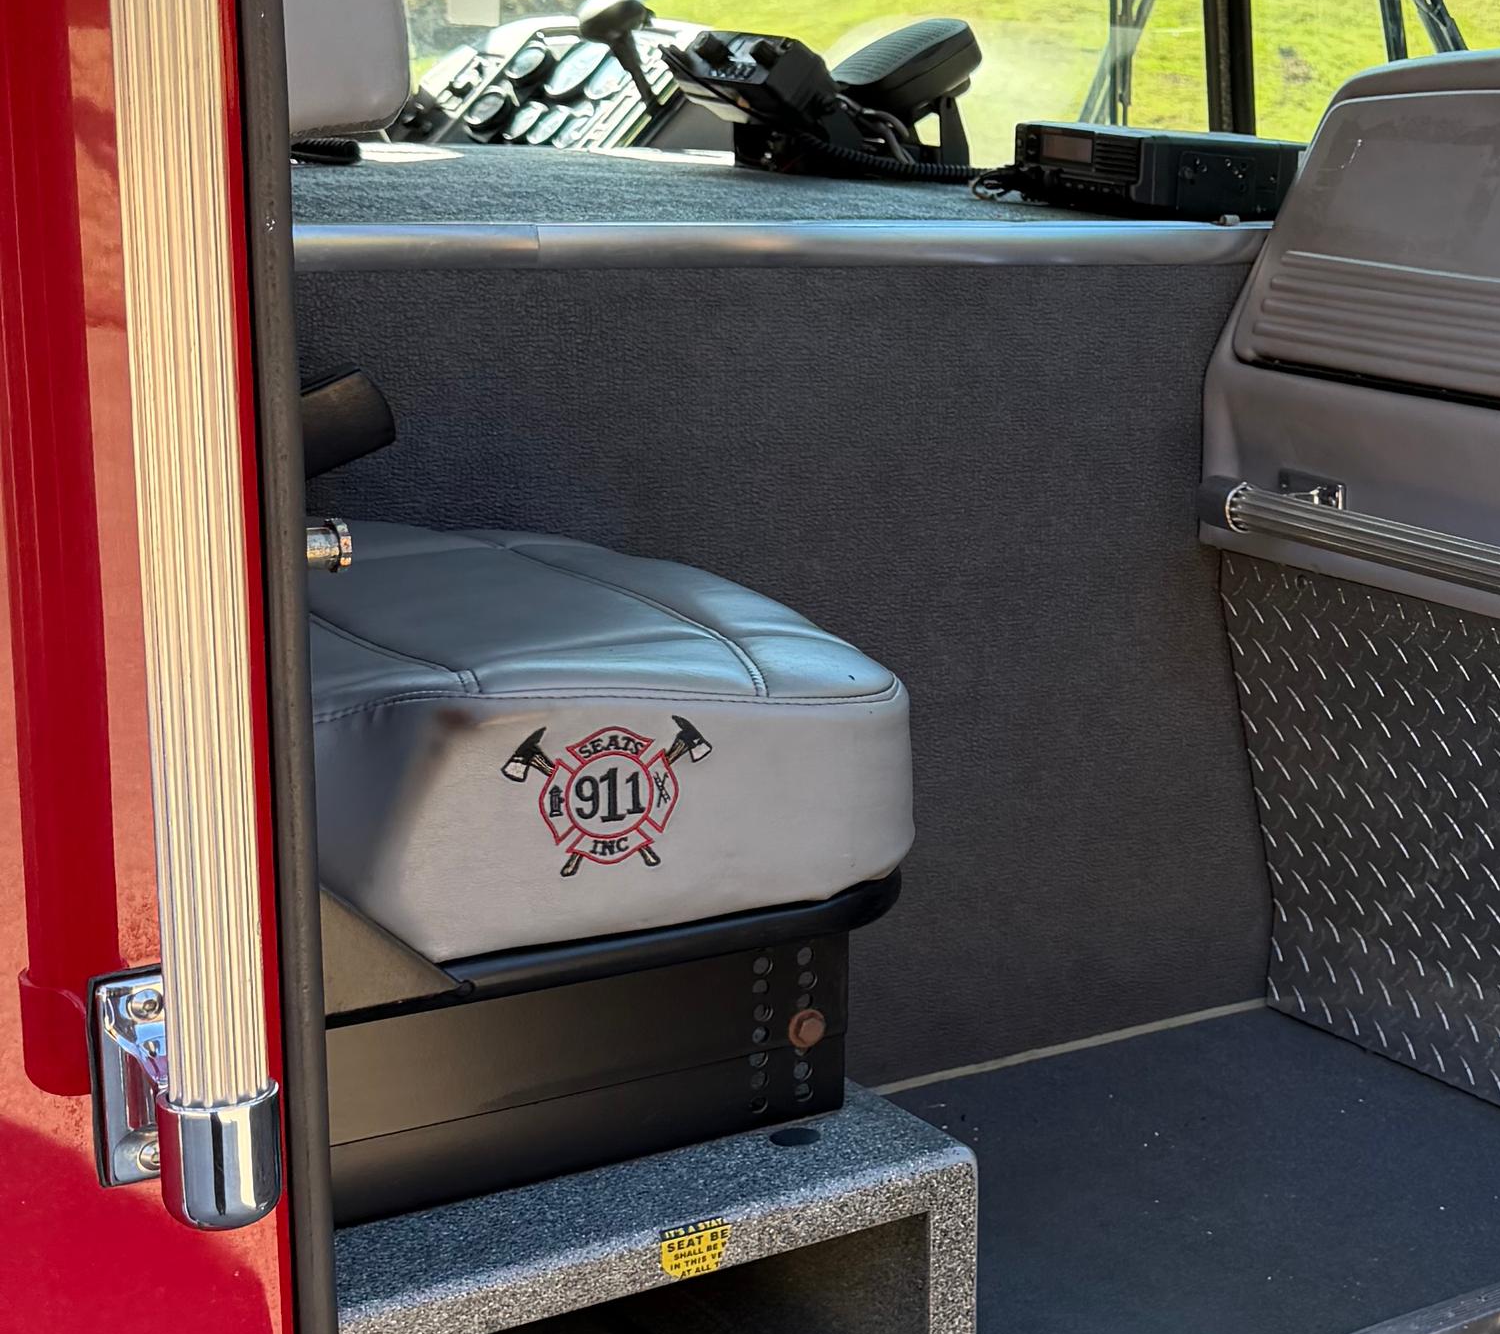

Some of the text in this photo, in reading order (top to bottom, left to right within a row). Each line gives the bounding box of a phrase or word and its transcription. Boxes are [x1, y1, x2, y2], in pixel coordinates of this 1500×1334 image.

[578, 735, 644, 759] SEATS
[575, 767, 645, 823] 911
[590, 837, 629, 856] INC
[697, 1218, 727, 1230] STAT
[667, 1235, 704, 1253] SEAT
[674, 1248, 703, 1261] SHALL
[706, 1243, 718, 1252] BE
[670, 1262, 681, 1271] IN
[685, 1255, 707, 1267] THIS
[681, 1269, 691, 1278] AT
[695, 1264, 711, 1273] ALL
